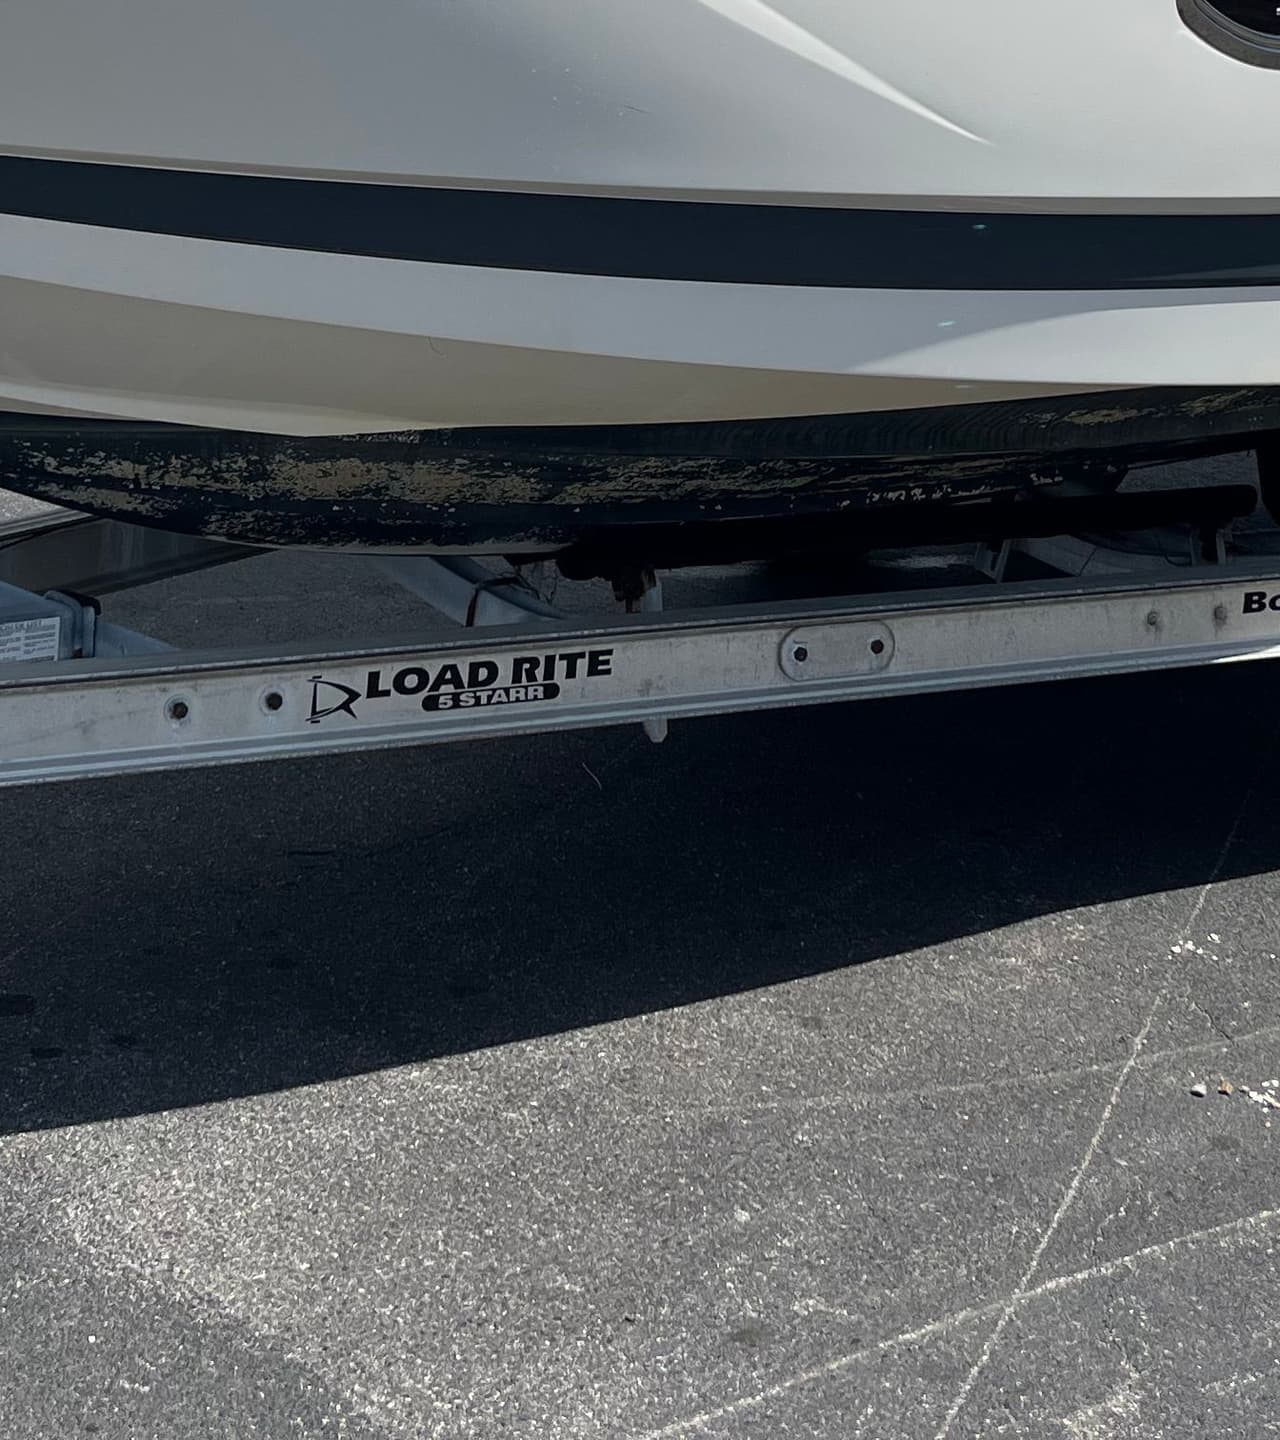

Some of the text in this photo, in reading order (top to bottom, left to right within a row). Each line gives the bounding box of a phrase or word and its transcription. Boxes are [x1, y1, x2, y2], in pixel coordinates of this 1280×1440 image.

[365, 648, 614, 700] LOAD RITE
[438, 686, 545, 709] 5 STARR
